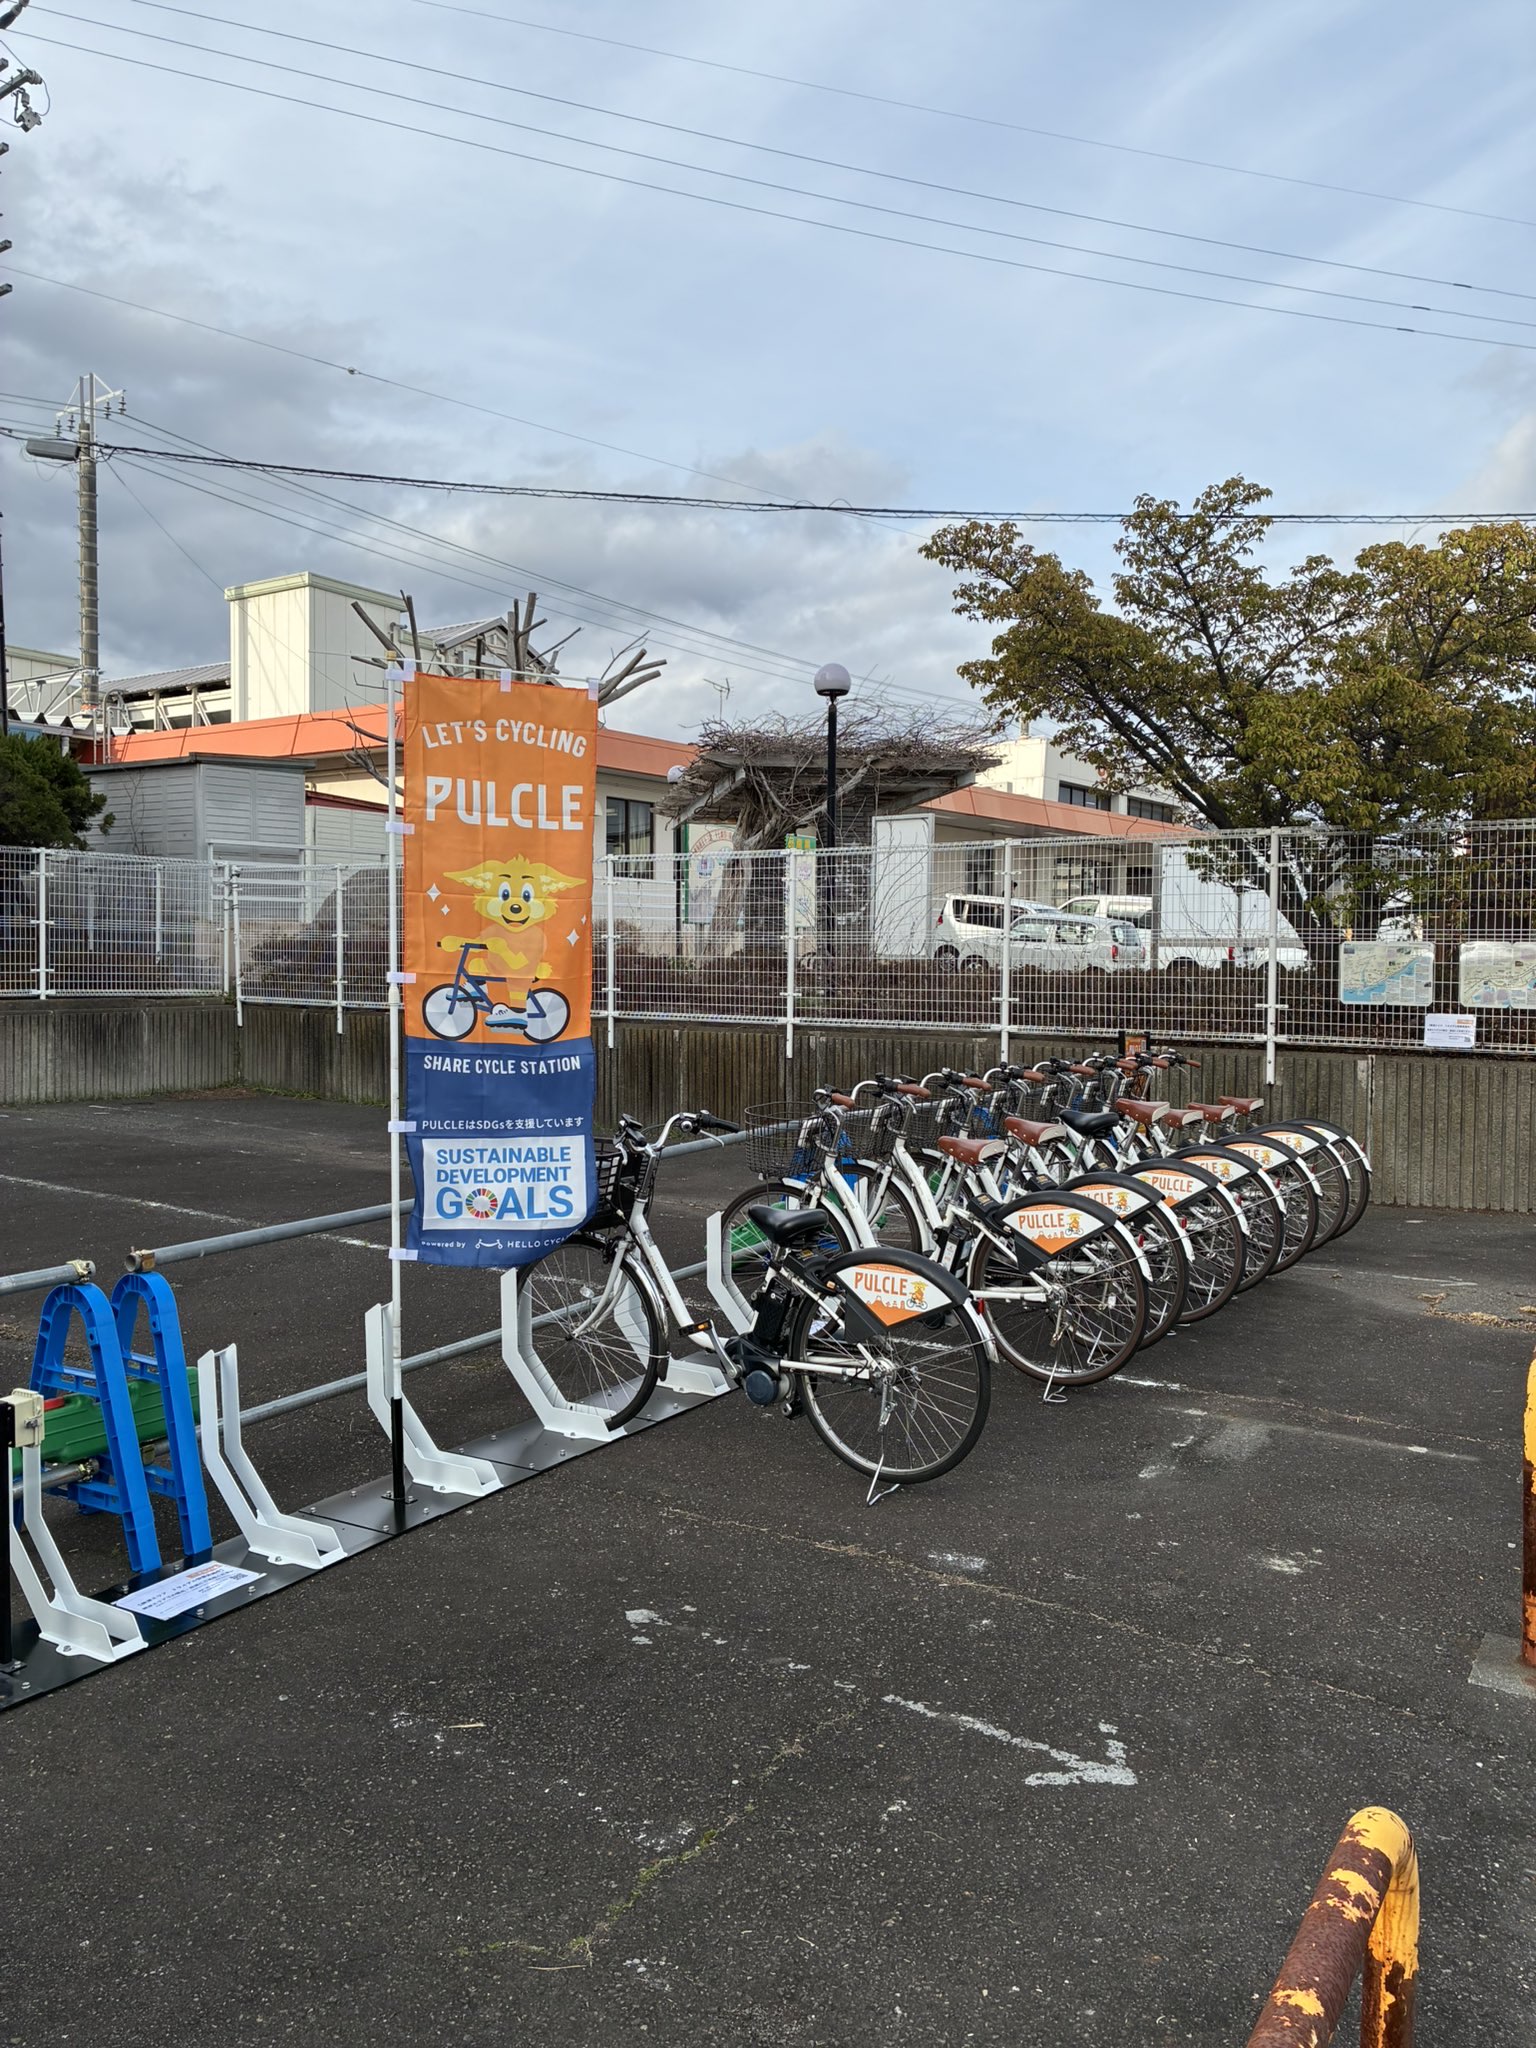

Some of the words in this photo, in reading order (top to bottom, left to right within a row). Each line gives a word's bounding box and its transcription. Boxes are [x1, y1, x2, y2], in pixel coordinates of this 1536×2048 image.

[422, 719, 487, 748] LET'S
[496, 718, 587, 757] CYCLING
[426, 776, 584, 830] PULCLE
[423, 1055, 471, 1074] SHARE
[475, 1060, 516, 1074] CYCLE
[521, 1055, 581, 1075] STATION
[422, 1116, 584, 1130] PULCLEはSDGsを支援しています
[436, 1146, 571, 1165] SUSTAINABLE
[436, 1166, 571, 1184] DEVELOPMENT
[1151, 1176, 1194, 1193] PULCLE
[436, 1185, 574, 1220] GOALS
[1018, 1213, 1065, 1229] PULCLE
[456, 1240, 466, 1249] by
[507, 1240, 541, 1248] HELLO
[855, 1272, 908, 1296] PULCLE
